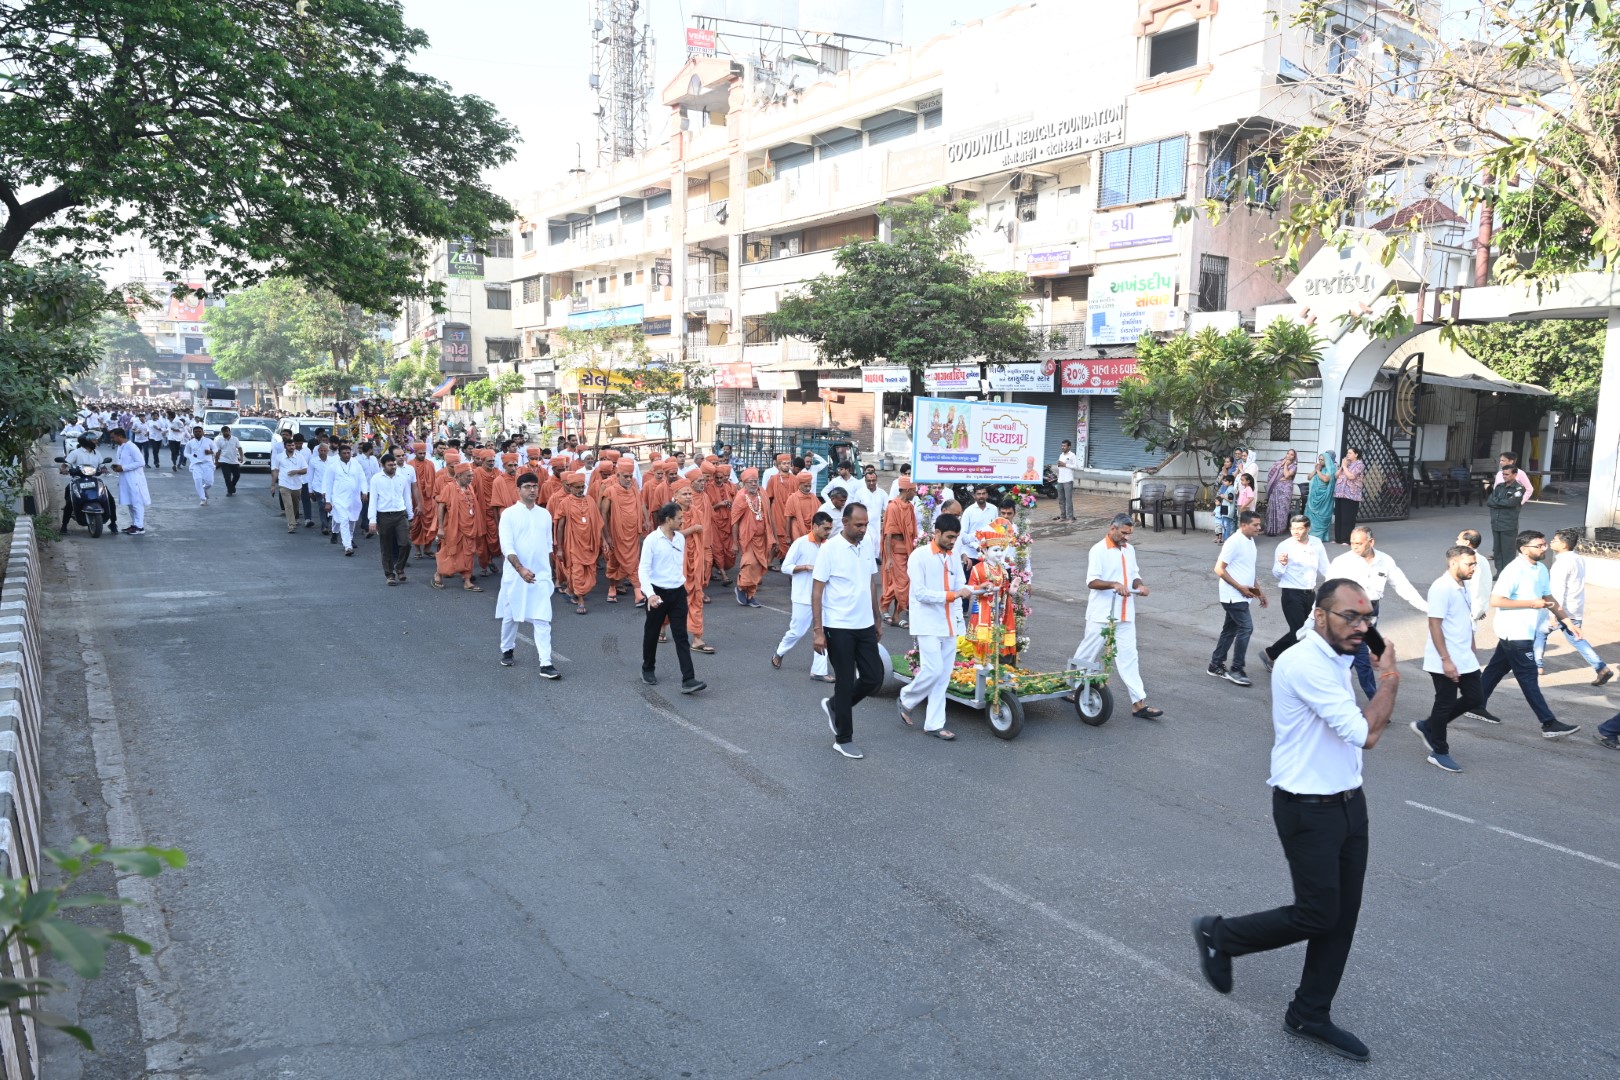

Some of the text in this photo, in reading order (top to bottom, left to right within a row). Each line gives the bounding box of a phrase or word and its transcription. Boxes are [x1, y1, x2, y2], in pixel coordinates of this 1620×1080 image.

[688, 32, 714, 42] VENUS
[948, 104, 1123, 163] GOODWILL MEDICAL FOUNDATION
[450, 251, 482, 265] ZEAL
[1110, 271, 1171, 293] અખંડદીપ
[1135, 292, 1171, 308] સોલાર
[1067, 368, 1085, 380] ૨૦%
[1092, 365, 1109, 375] રાહત
[744, 408, 772, 424] KAKA
[984, 432, 1024, 444] પદયાત્રા
